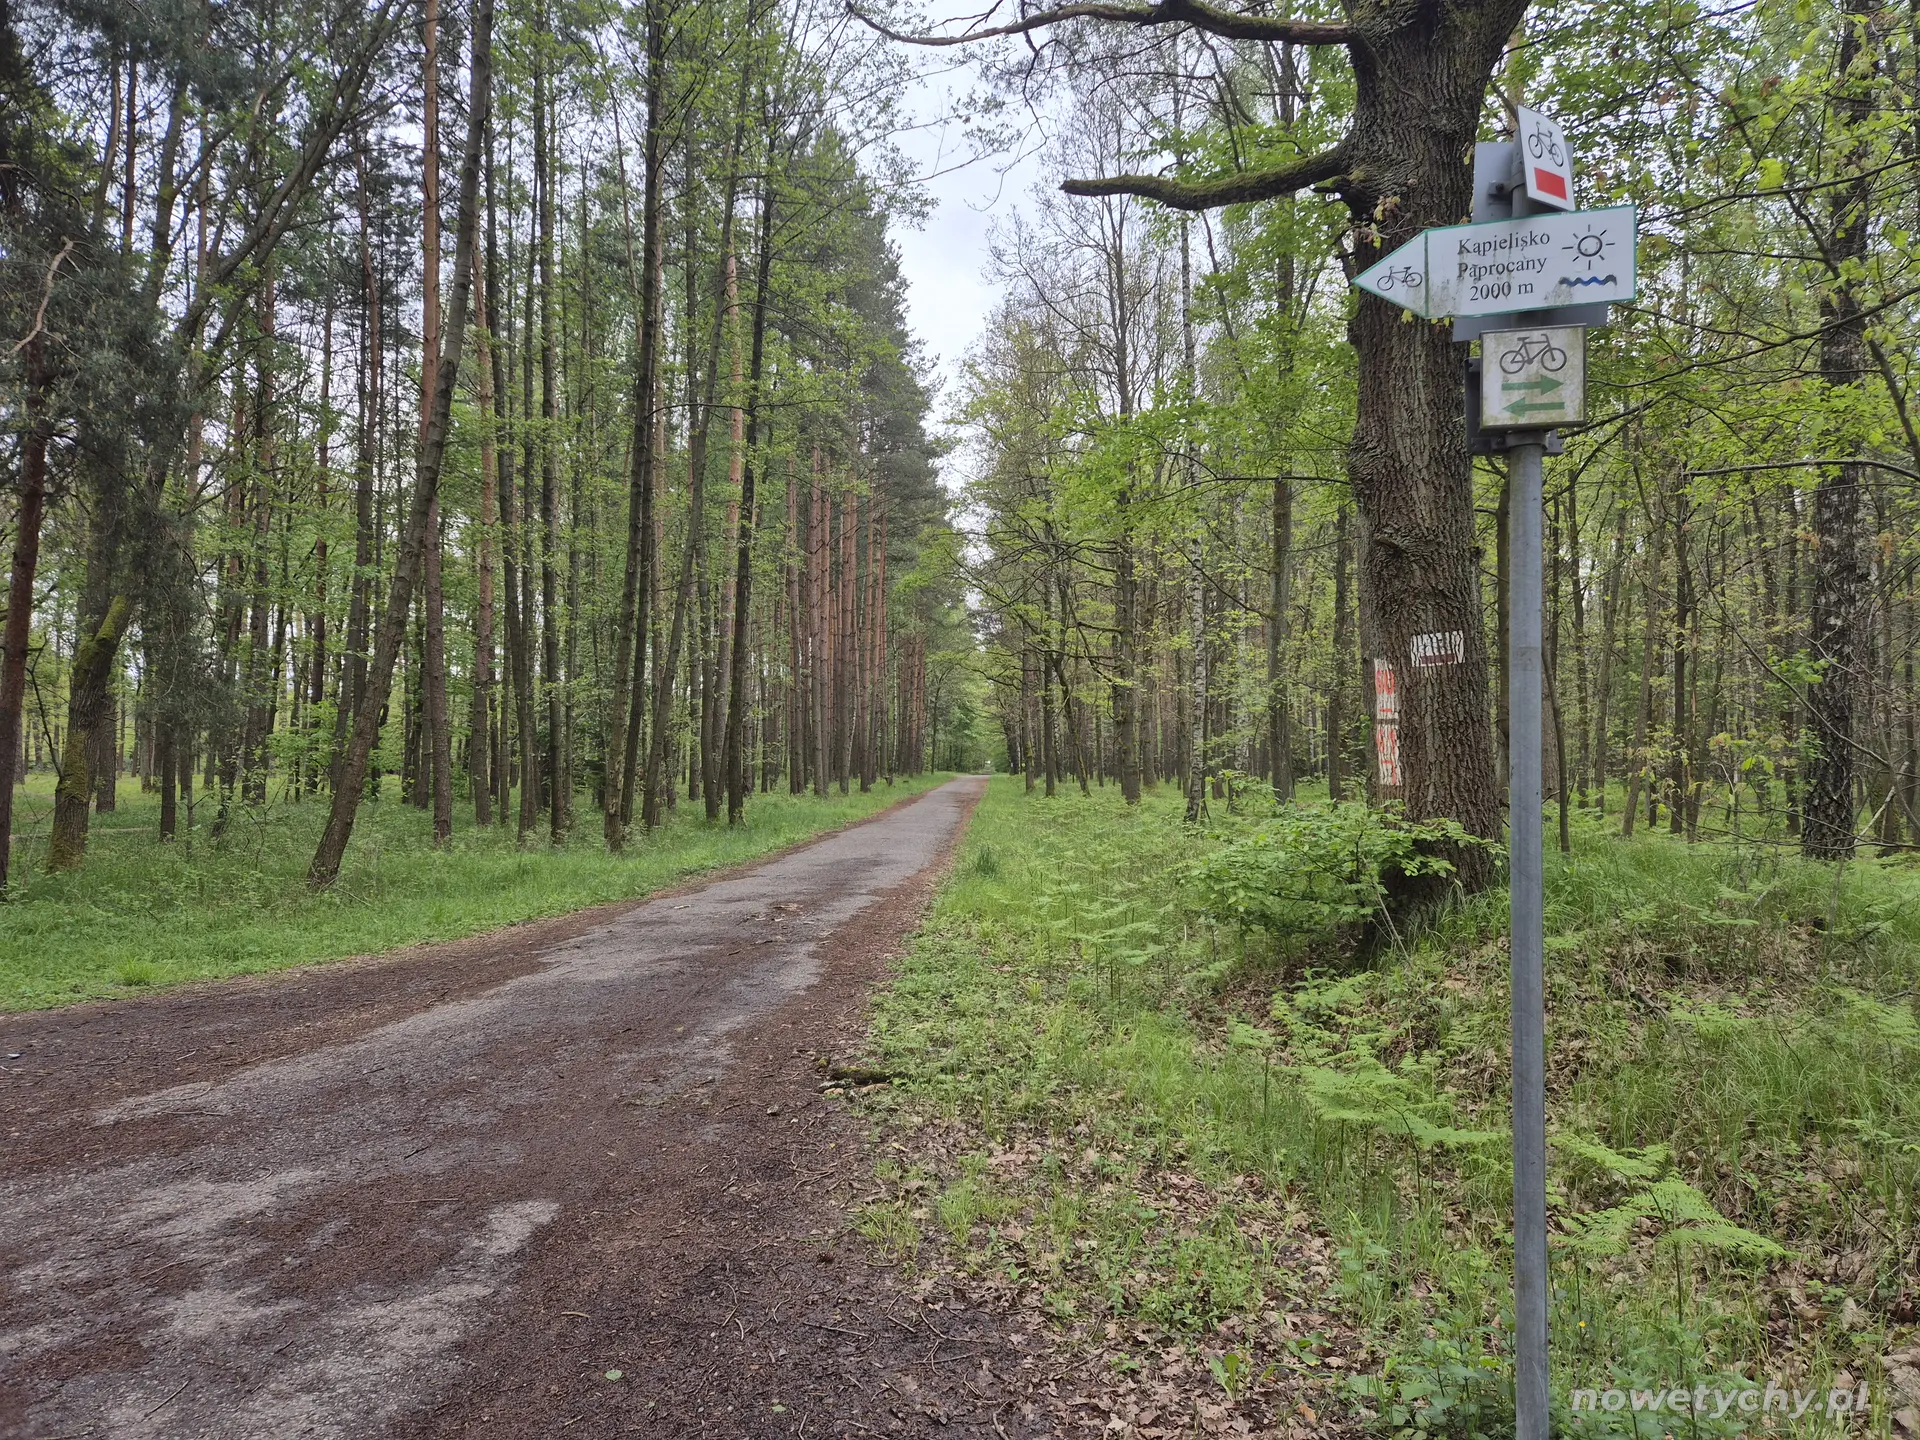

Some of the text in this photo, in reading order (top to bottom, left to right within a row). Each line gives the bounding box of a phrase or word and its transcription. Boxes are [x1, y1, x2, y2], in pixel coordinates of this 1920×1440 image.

[1457, 231, 1550, 256] Kąpielisko
[1457, 257, 1547, 281] Paprocany
[1470, 281, 1534, 301] 2000 m
